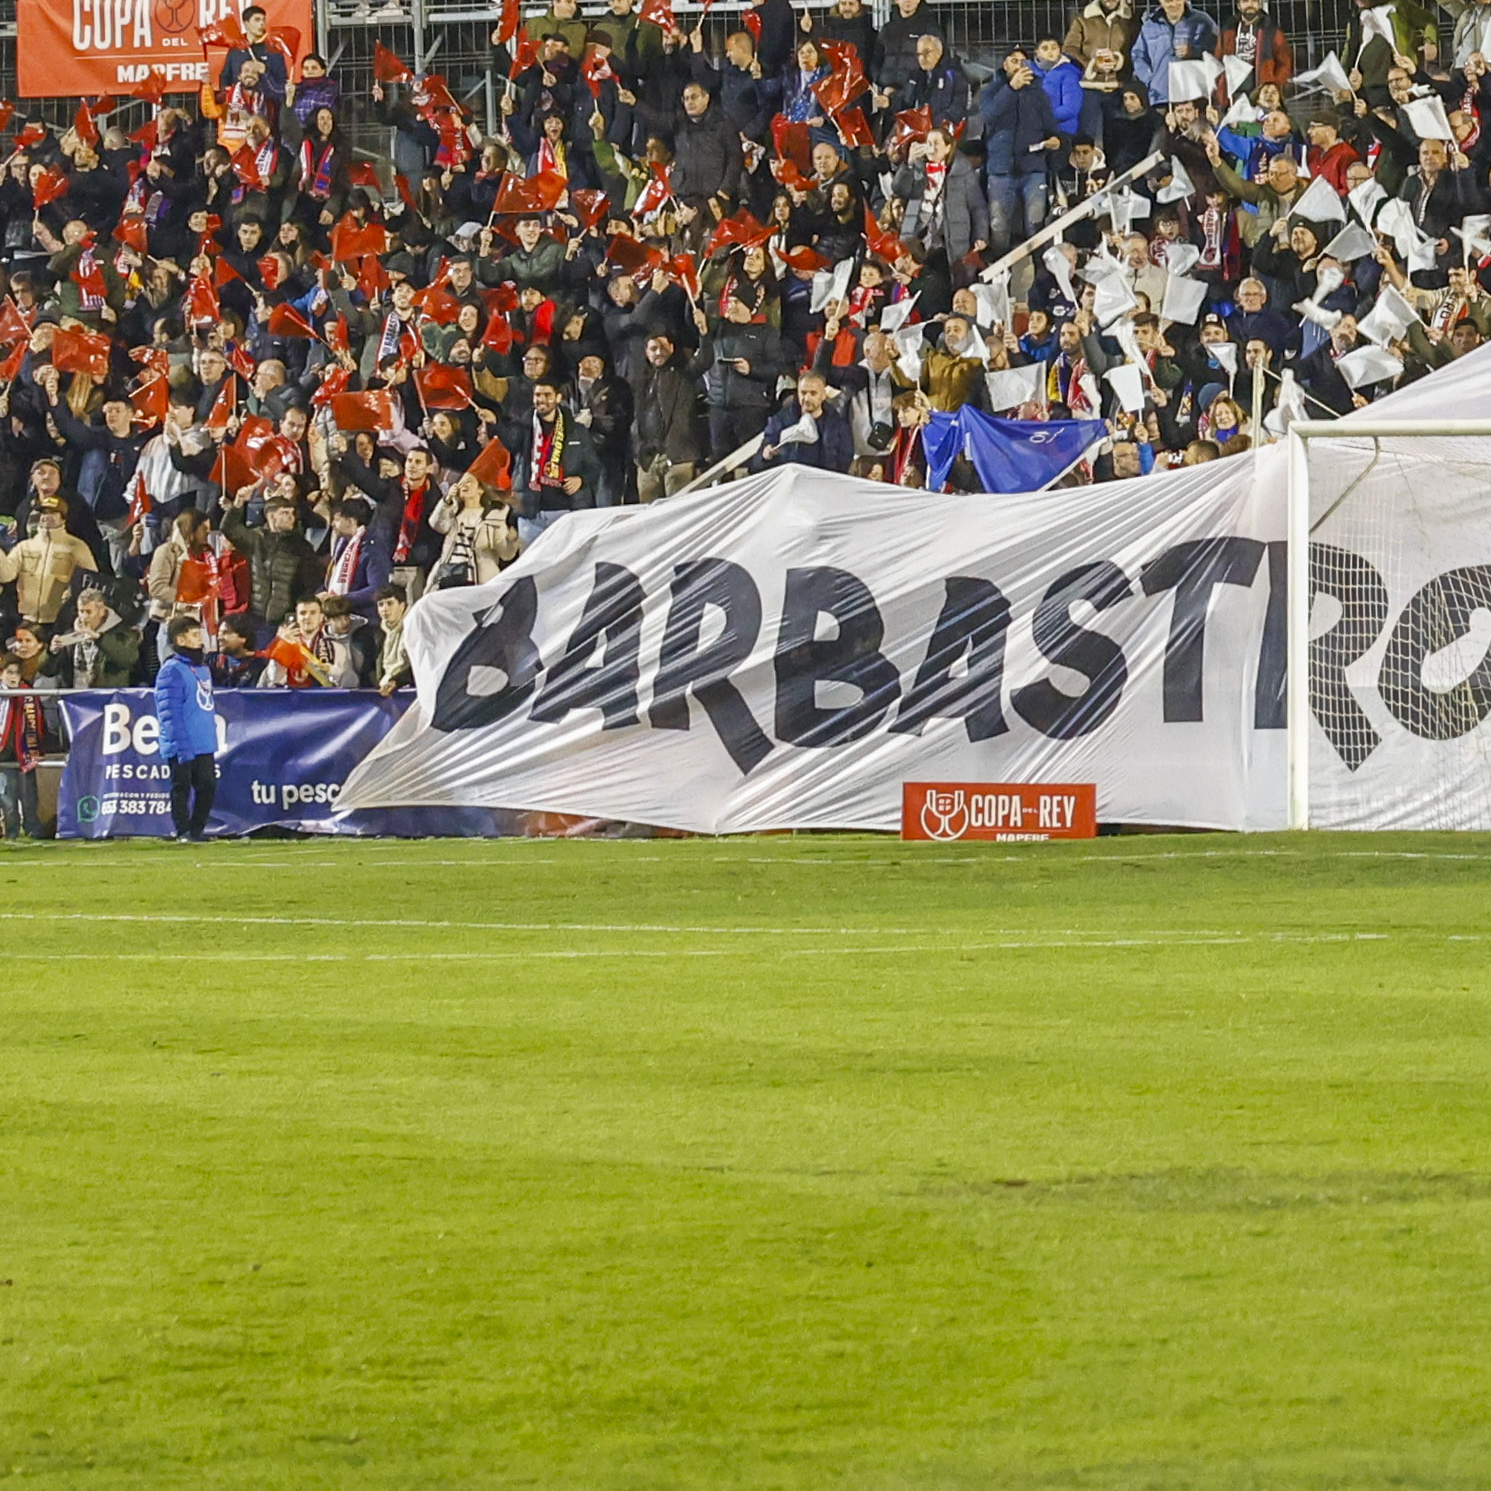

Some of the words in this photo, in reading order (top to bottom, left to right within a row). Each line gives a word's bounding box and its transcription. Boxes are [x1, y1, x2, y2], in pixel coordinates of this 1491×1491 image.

[162, 38, 188, 47] DEL
[119, 799, 146, 814] 383
[251, 780, 276, 804] tu
[282, 784, 341, 811] pesc
[970, 794, 1022, 827] COPA
[1039, 795, 1076, 828] REY
